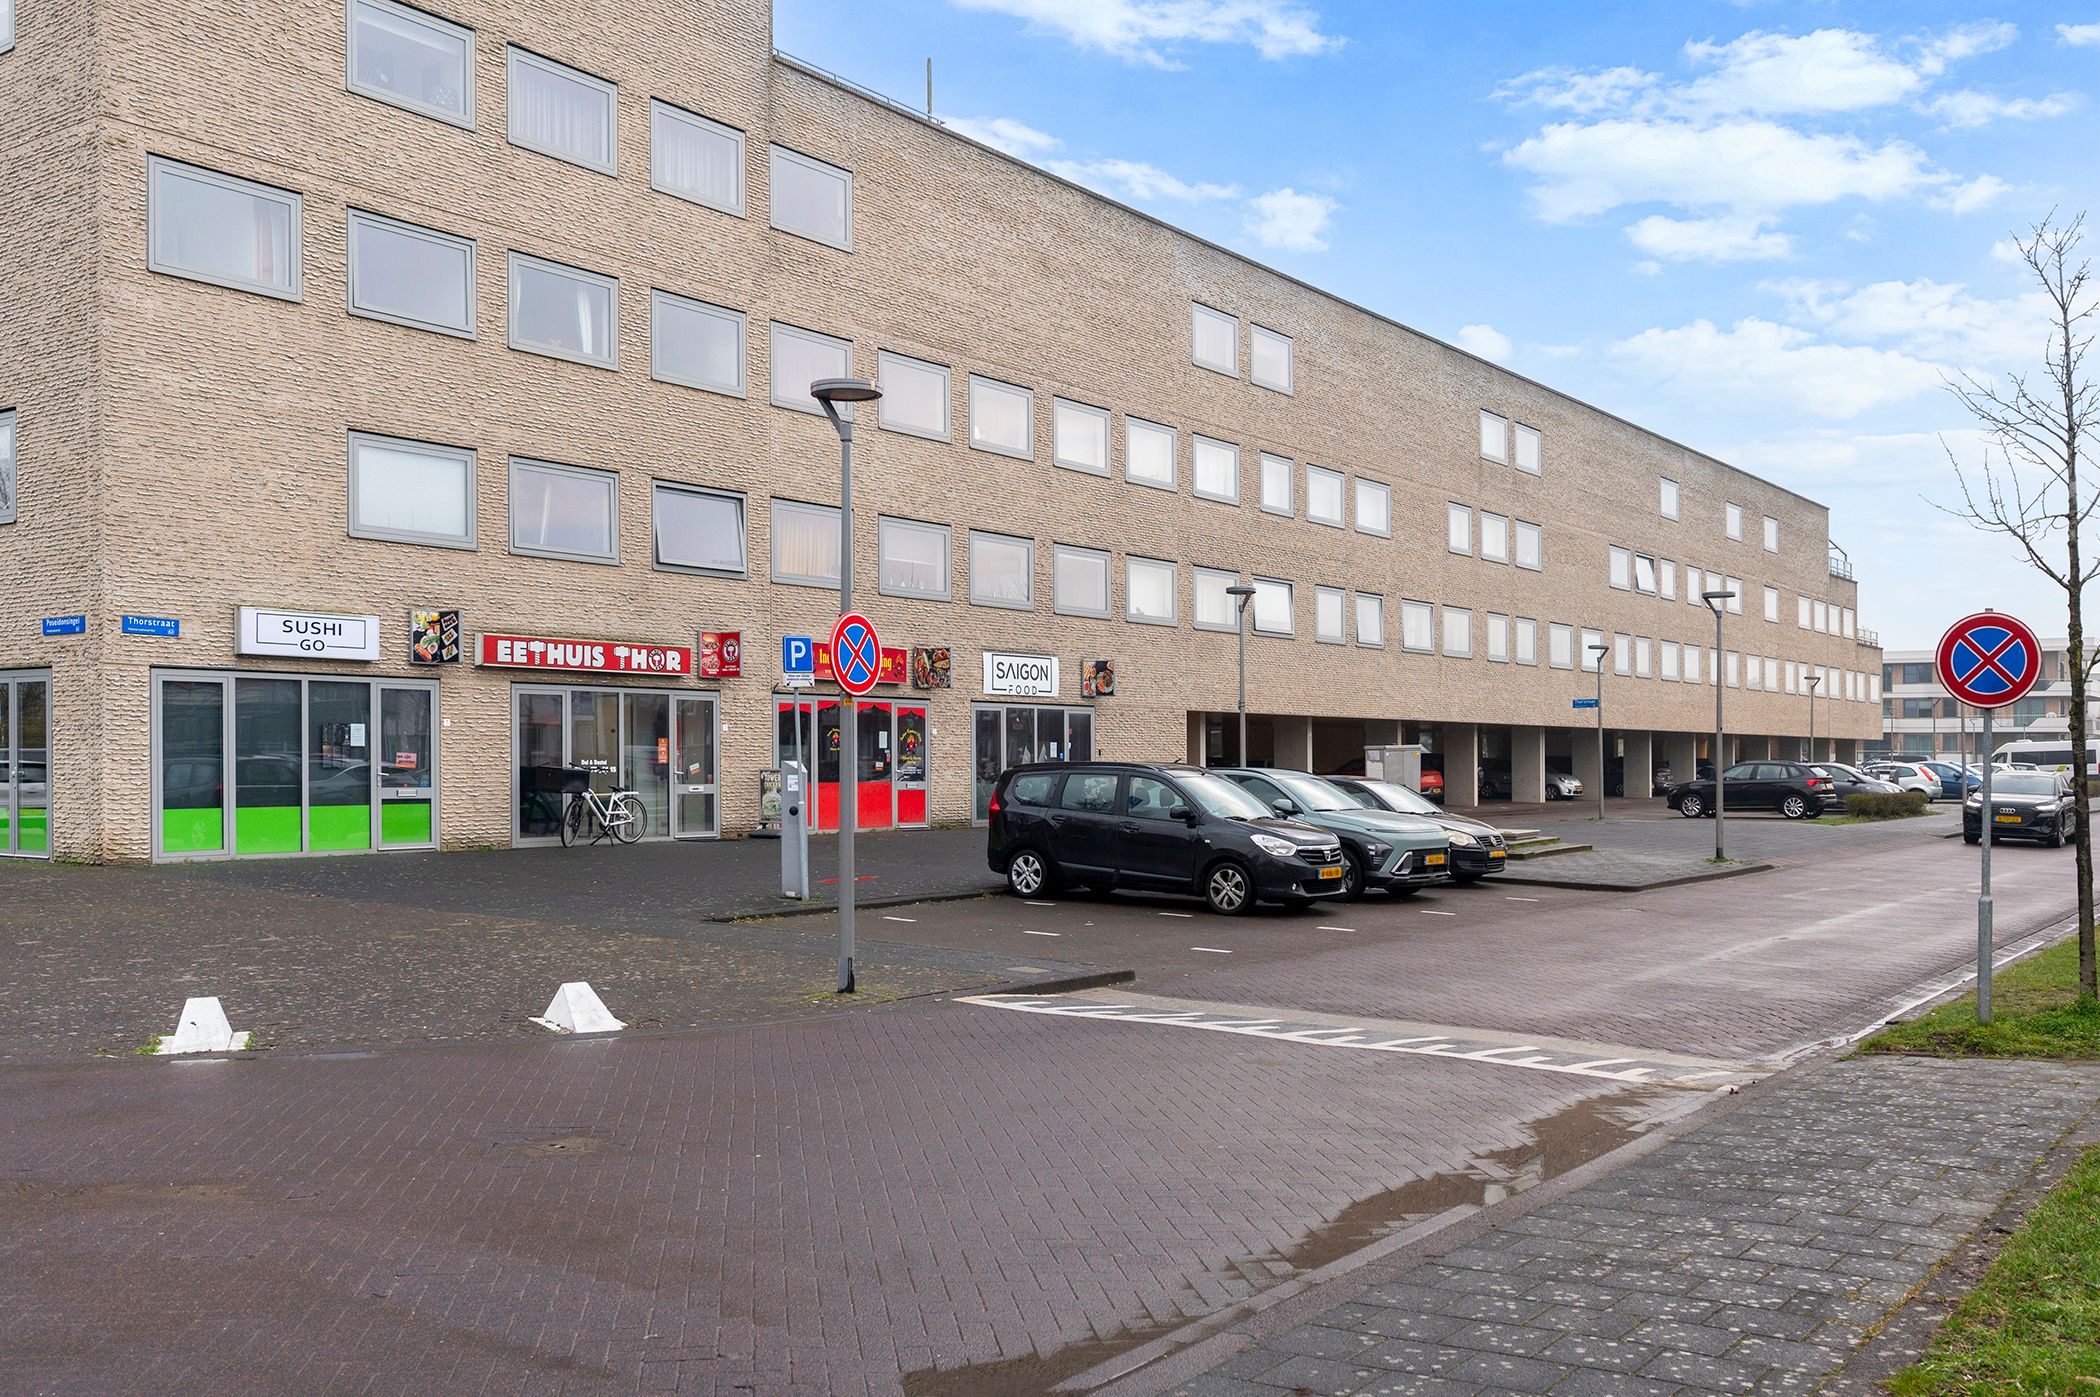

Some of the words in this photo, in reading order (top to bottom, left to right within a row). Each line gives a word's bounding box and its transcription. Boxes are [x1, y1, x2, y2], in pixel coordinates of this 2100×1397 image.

[46, 617, 80, 627] Poseidonsingel
[128, 616, 176, 628] Thorstraat
[282, 619, 343, 637] SUSHI
[299, 639, 325, 651] GO
[496, 639, 606, 668] EETHUIS
[613, 645, 682, 672] THOR
[790, 640, 807, 669] P
[995, 661, 1049, 681] SAIGON
[1008, 684, 1038, 696] FOOD
